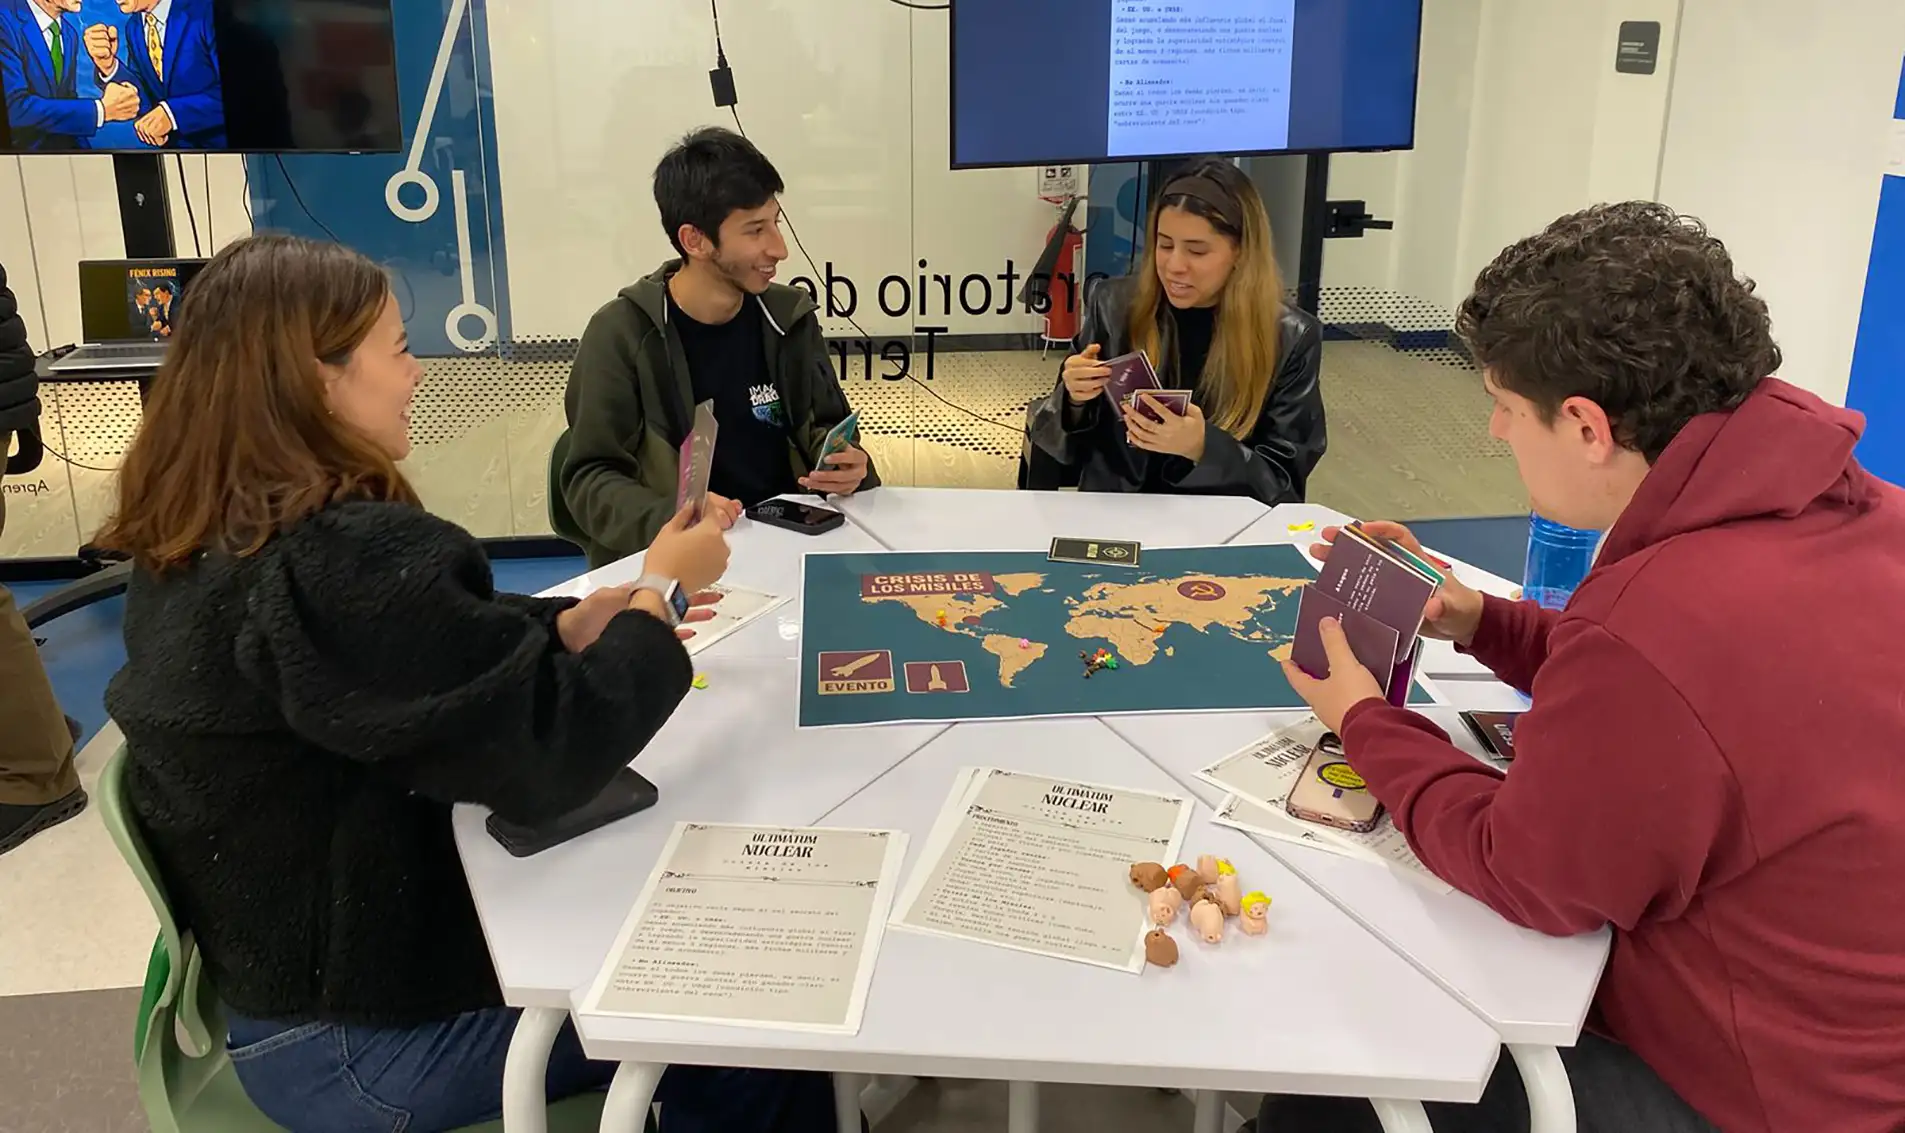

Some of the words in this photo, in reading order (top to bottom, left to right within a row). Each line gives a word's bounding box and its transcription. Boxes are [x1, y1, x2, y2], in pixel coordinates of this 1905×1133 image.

[152, 268, 177, 277] RISING
[874, 574, 947, 585] CRISIS
[954, 572, 980, 583] DE
[871, 584, 905, 594] LOS
[910, 581, 985, 592] MISILES
[825, 681, 889, 693] EVENTO
[1264, 743, 1312, 768] NUCLEAR
[1051, 784, 1113, 802] ULTIMATUM
[1040, 793, 1109, 814] NUCLEAR
[751, 833, 818, 845] ULTIMATUM
[741, 844, 813, 858] NUCLEAR
